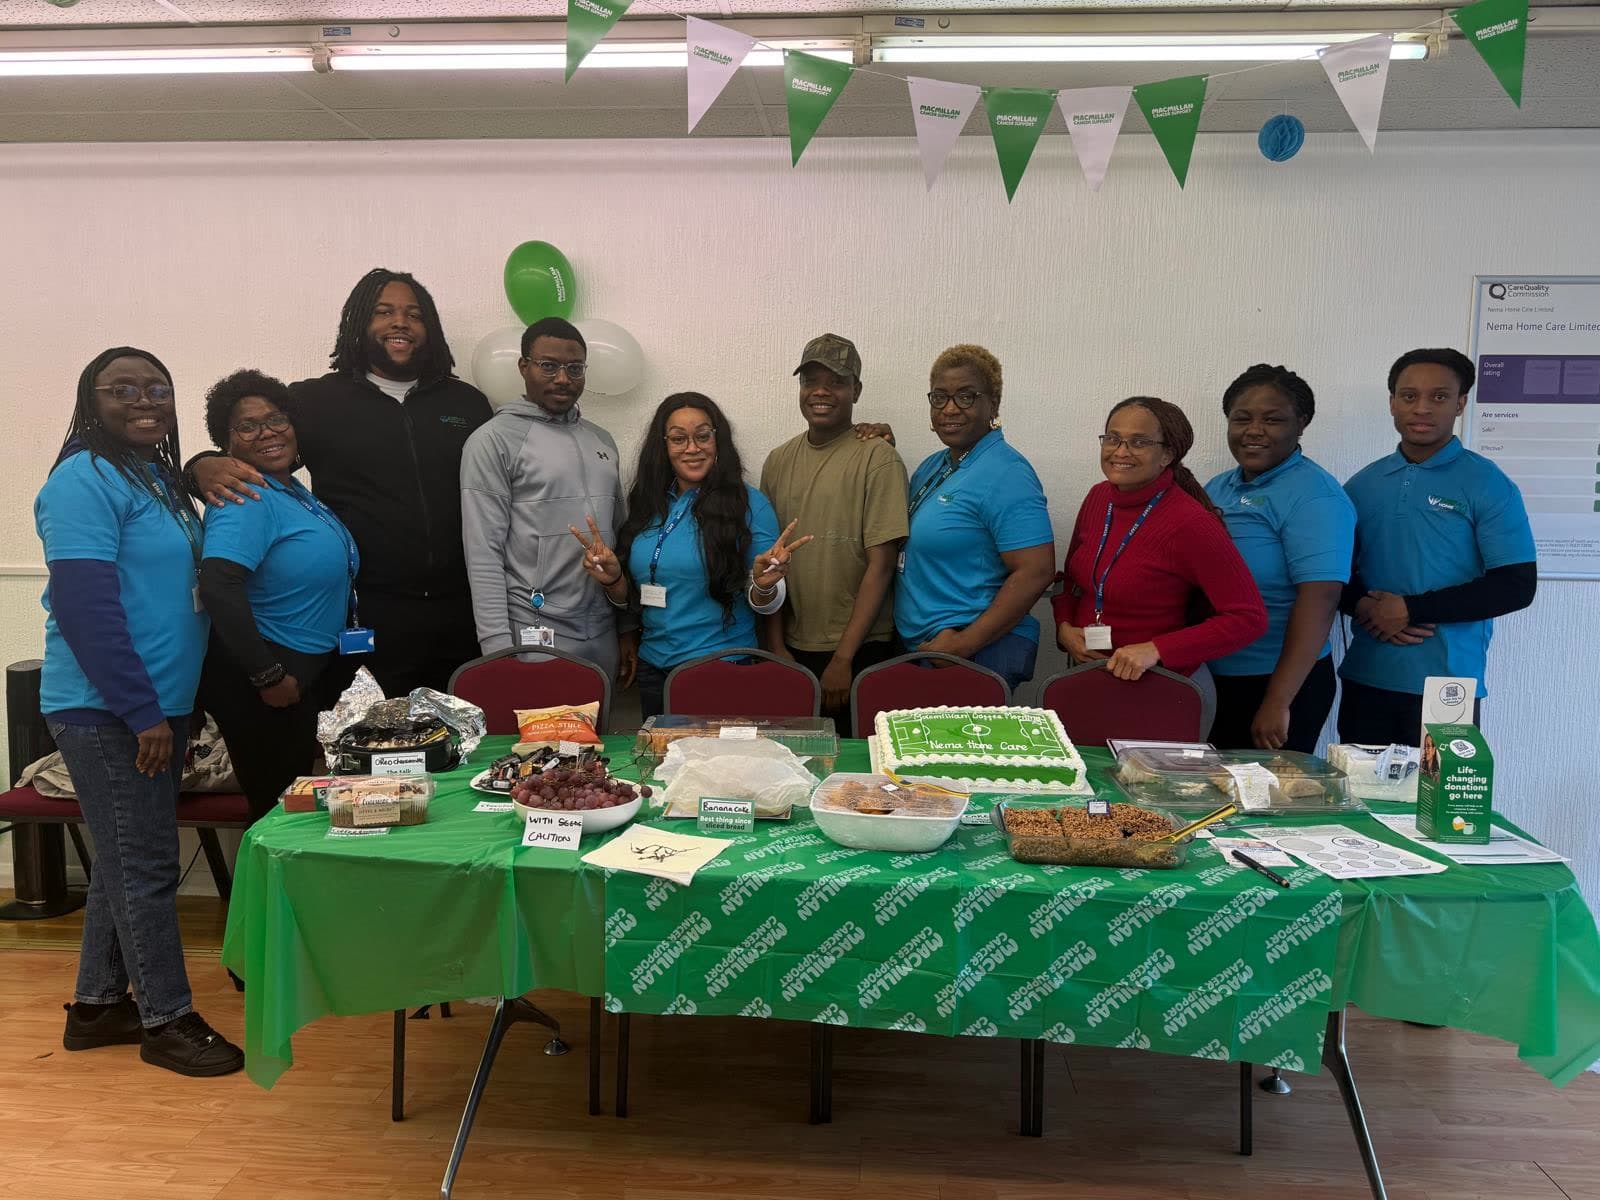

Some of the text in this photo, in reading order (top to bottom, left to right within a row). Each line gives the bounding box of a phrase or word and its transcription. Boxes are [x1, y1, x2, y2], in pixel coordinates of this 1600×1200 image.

[694, 45, 732, 62] MACMILLAN
[1476, 19, 1518, 37] MACMILLAN
[792, 78, 832, 92] MACMILLAN
[1338, 64, 1379, 78] MACMILLAN
[920, 105, 960, 115] MACMILLAN
[1152, 103, 1193, 114] MACMILLAN
[1486, 322, 1513, 330] Nema
[1516, 322, 1542, 330] Home
[1546, 322, 1566, 330] Care
[930, 740, 1028, 751] Nema Home Care
[1444, 783, 1488, 791] donations
[1446, 774, 1487, 784] changing
[716, 816, 733, 824] thing
[721, 863, 806, 916] MACMILLAN
[797, 866, 881, 920] MACMILLAN
[954, 874, 1035, 932] MACMILLAN
[1028, 890, 1071, 924] SUPPORT
[1030, 880, 1115, 939] MACMILLAN
[1106, 896, 1151, 931] SUPPORT
[1108, 885, 1196, 947] MACMILLAN
[668, 911, 701, 941] CANCER
[1186, 905, 1231, 941] SUPPORT
[1187, 888, 1279, 956] MACMILLAN
[1265, 890, 1342, 949] ANCER SUPPORT
[1266, 898, 1343, 964] ACMILLAN
[630, 940, 669, 981] SUPPORT
[632, 917, 712, 995] MACMILLAN
[704, 915, 778, 984] CANCER SUPPORT
[707, 922, 788, 997] MACMILLAN
[779, 921, 854, 988] CANCER SUPPORT
[782, 926, 865, 1002] MACMILLAN
[856, 926, 933, 994] CANCER SUPPORT
[858, 932, 944, 1008] MACMILLAN
[934, 932, 1008, 1003] CANCER SUPPORT
[936, 938, 1019, 1018] MACMILLAN
[1007, 940, 1087, 1006] CANCER SUPPORT
[1008, 946, 1097, 1020] MACMILLAN
[1086, 948, 1166, 1014] CANCER SUPPORT
[1087, 954, 1175, 1027] MACMILLAN
[1163, 959, 1245, 1023] CANCER SUPPORT
[1164, 965, 1254, 1036] MACMILLAN
[1238, 967, 1322, 1030] CANCER SUPPORT
[1238, 974, 1332, 1044] MACMILLAN
